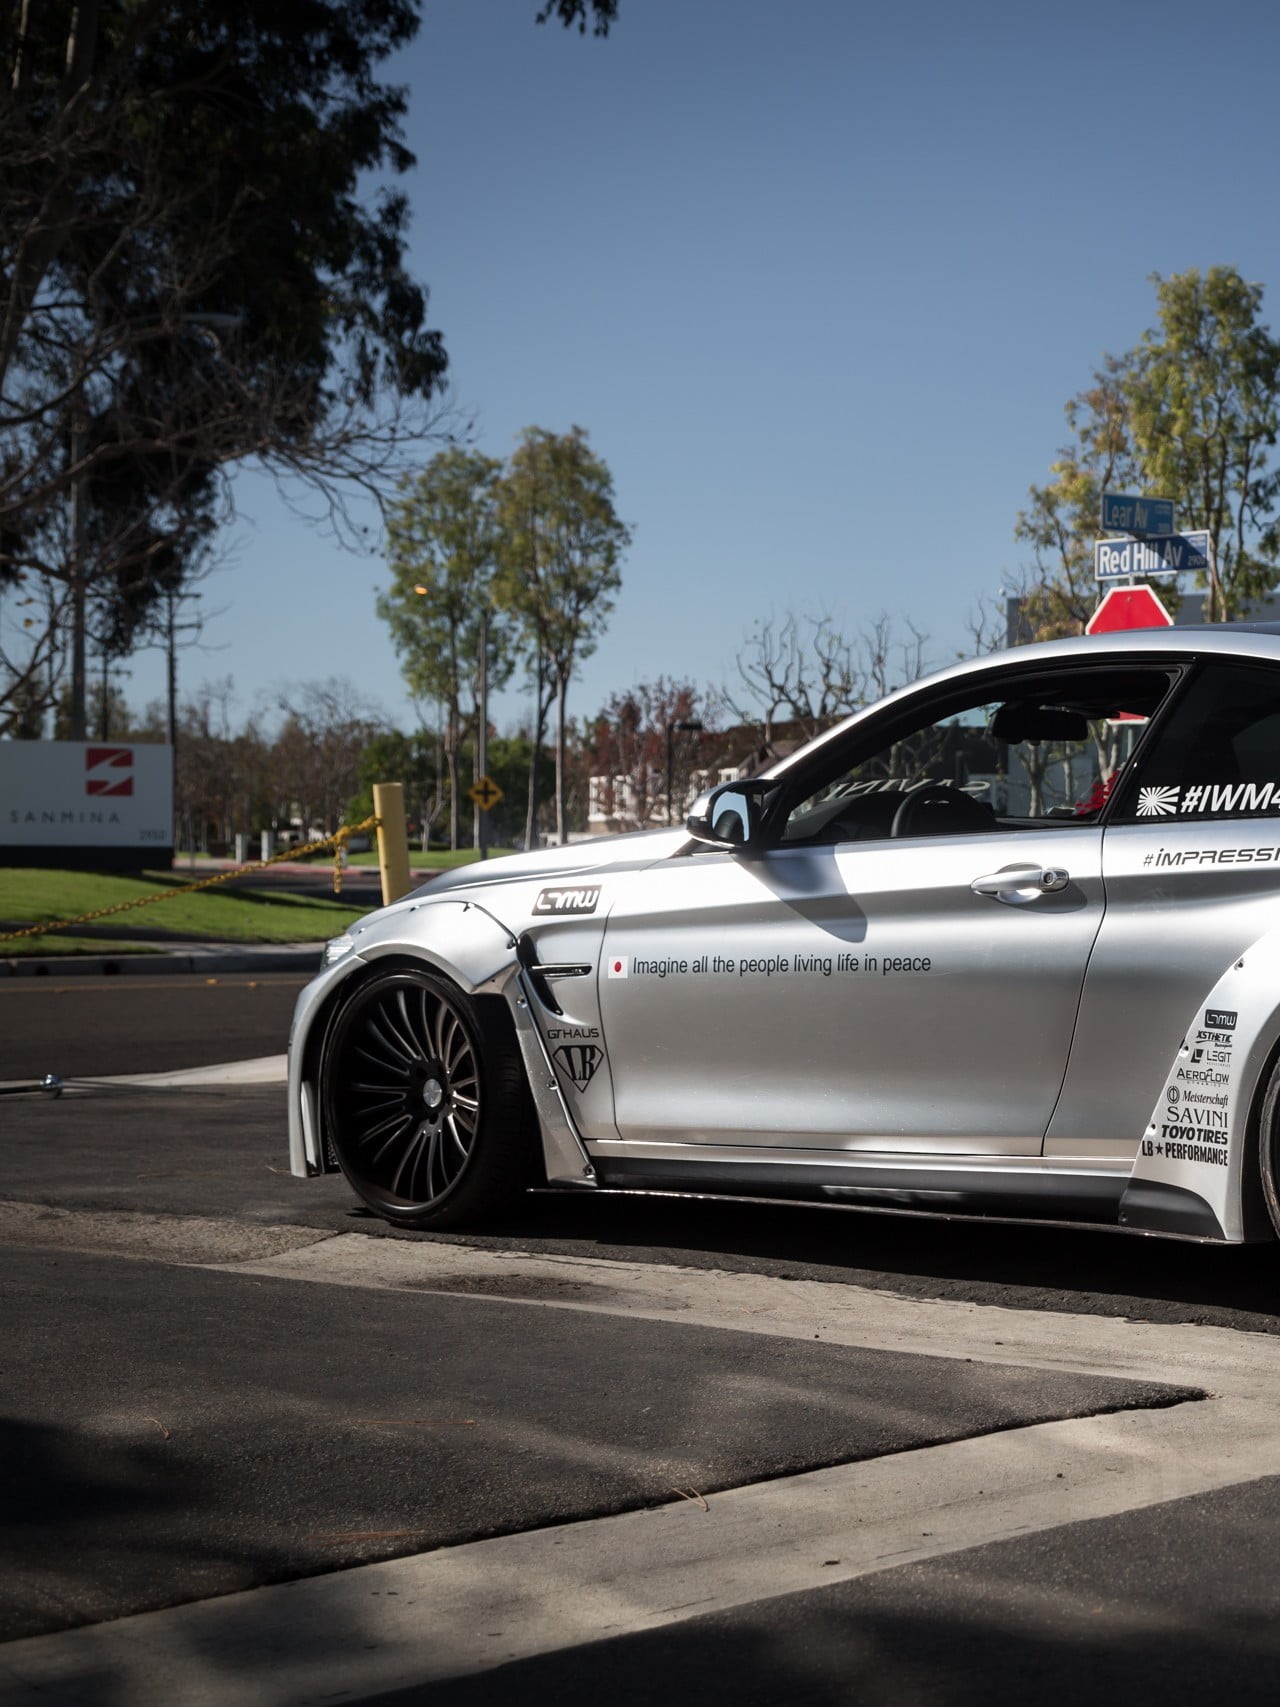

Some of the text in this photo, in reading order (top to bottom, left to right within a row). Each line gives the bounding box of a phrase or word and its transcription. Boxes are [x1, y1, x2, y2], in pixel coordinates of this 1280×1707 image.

[1104, 499, 1132, 527] Lear
[1134, 503, 1148, 529] Av
[1099, 541, 1183, 574] Red Hill Av
[9, 810, 121, 824] SANMINA
[633, 954, 931, 977] Imagine all the people living life in peace
[547, 1027, 600, 1041] GTHAUS
[1206, 1050, 1232, 1064] LEGIT
[1182, 1090, 1229, 1109] Meisterschaft
[1166, 1106, 1228, 1128] SAVINI
[1161, 1125, 1228, 1145] TOYO TIRES
